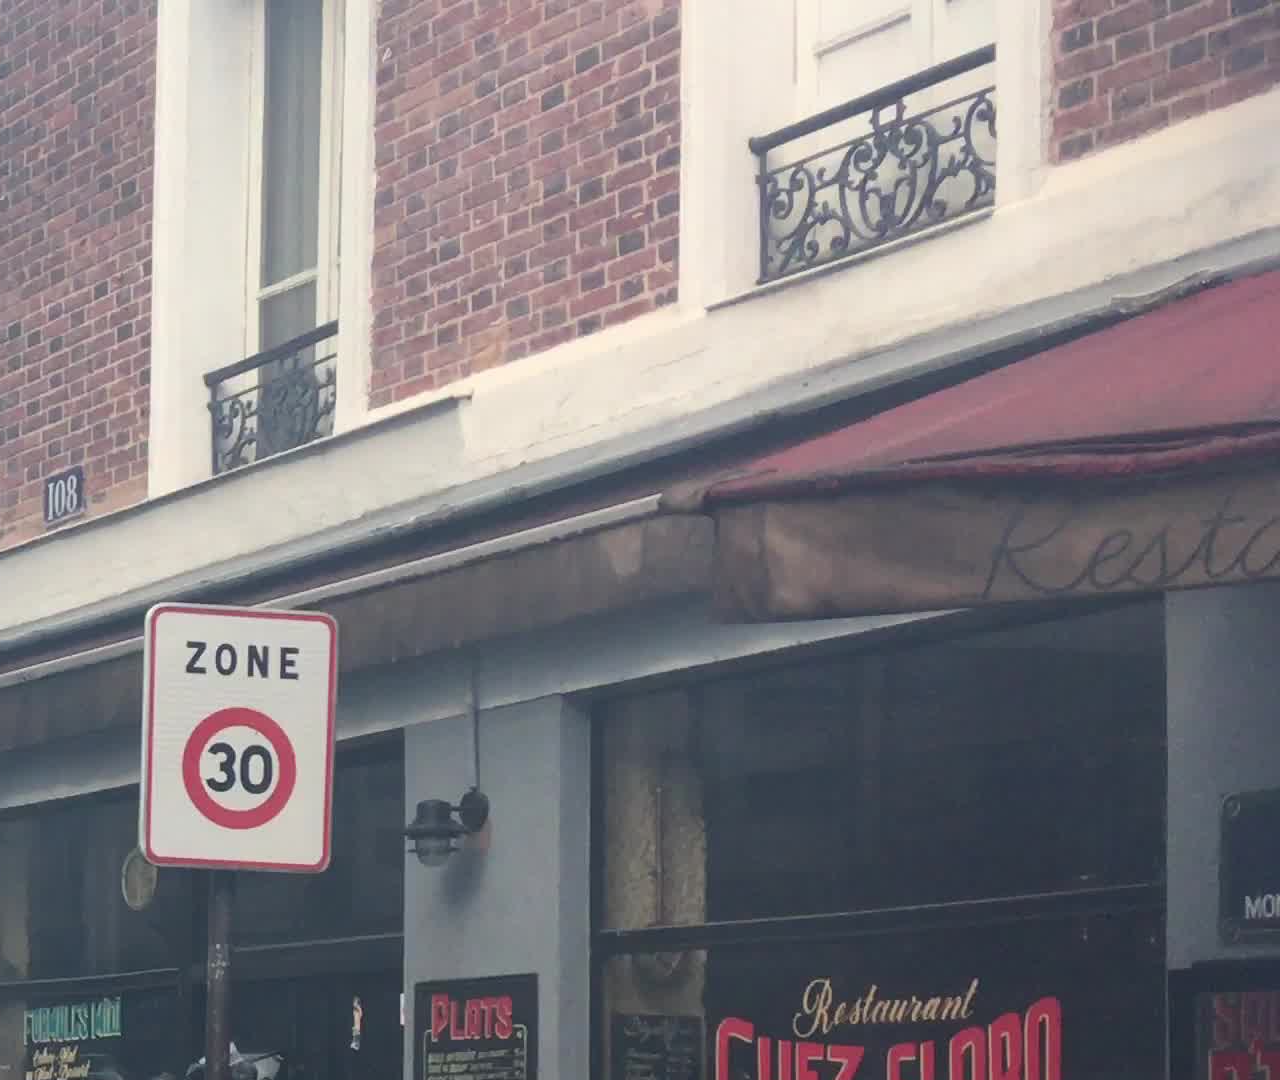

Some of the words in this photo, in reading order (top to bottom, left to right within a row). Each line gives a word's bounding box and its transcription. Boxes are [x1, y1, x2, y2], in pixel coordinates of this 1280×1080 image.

[46, 475, 79, 522] 108
[184, 640, 301, 681] ZONE
[205, 742, 274, 795] 30
[431, 994, 513, 1042] PLATS
[793, 976, 980, 1039] Restaurant
